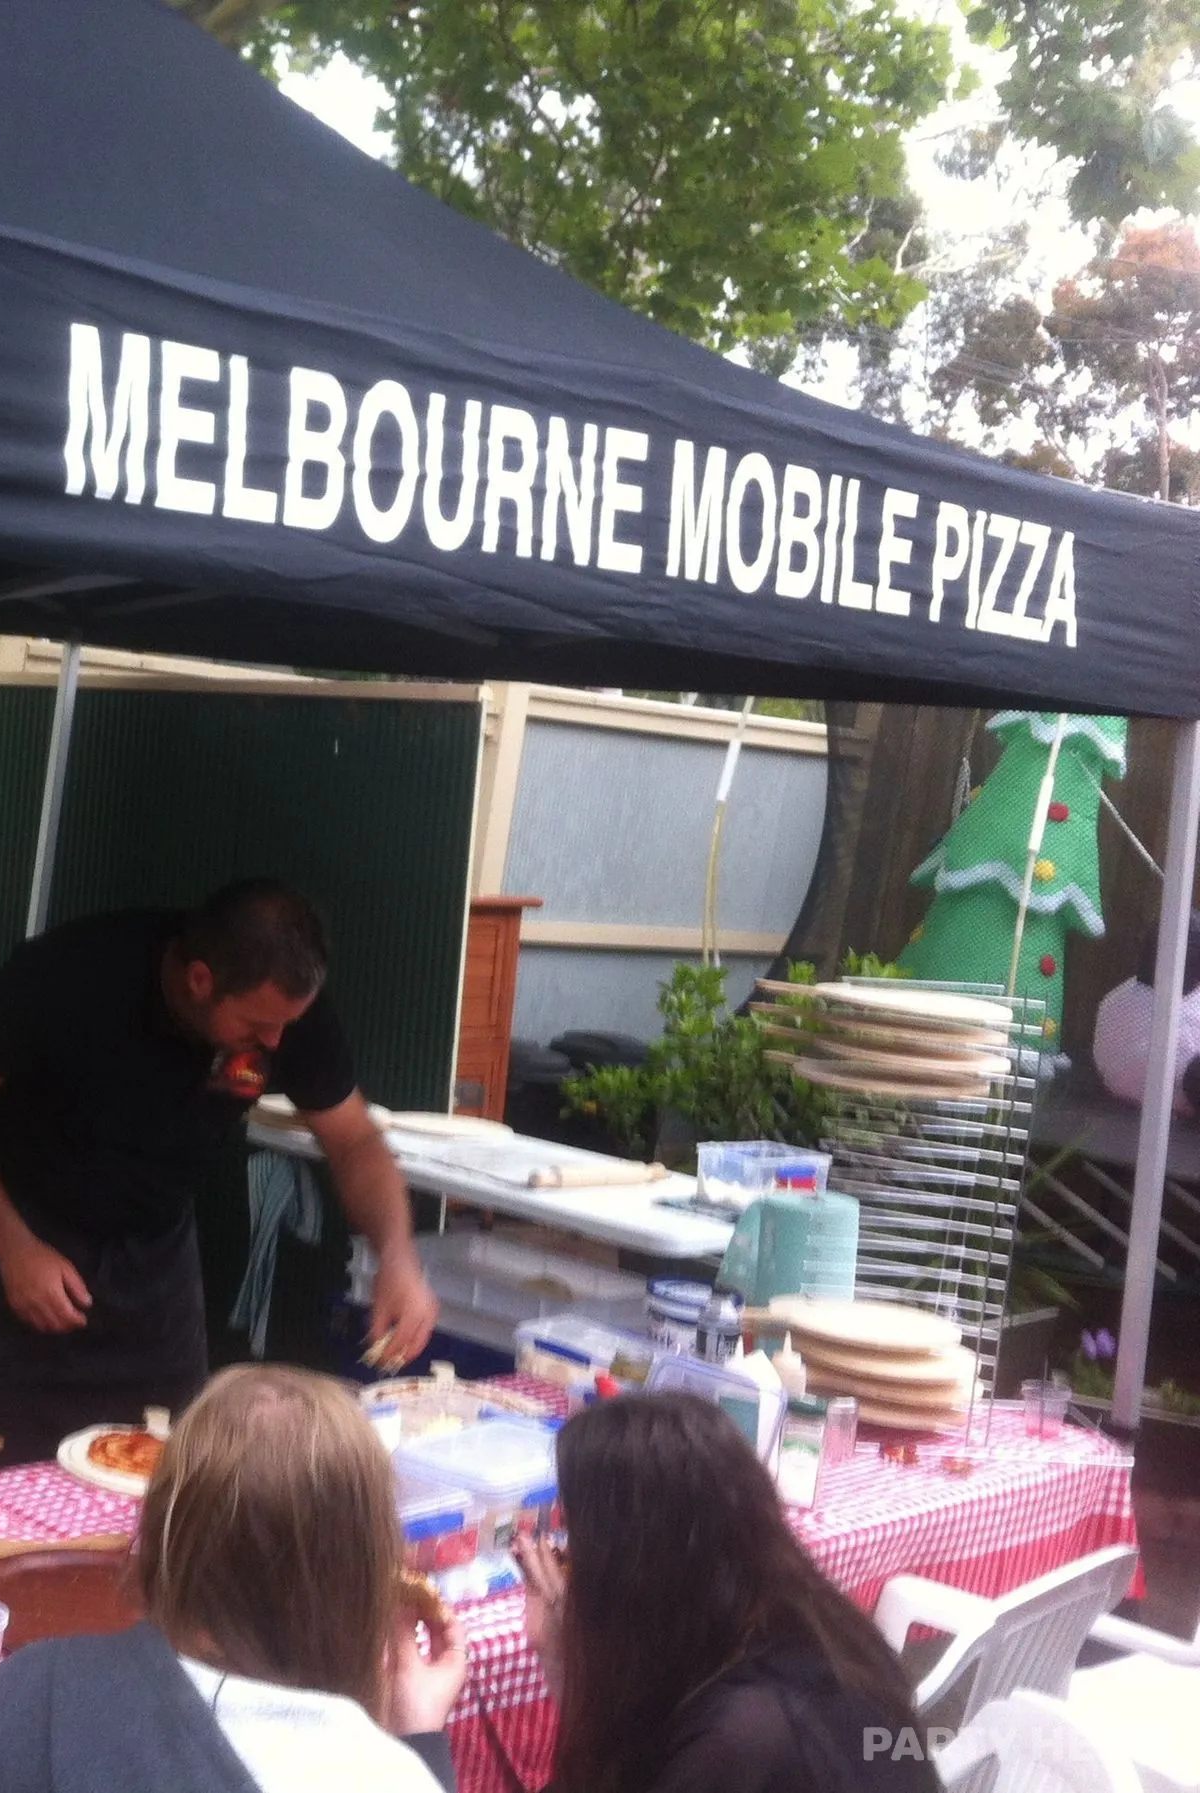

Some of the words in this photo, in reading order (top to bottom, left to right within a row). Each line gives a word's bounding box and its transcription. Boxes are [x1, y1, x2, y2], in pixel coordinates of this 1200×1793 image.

[64, 322, 648, 574] MELBOURNE
[666, 438, 920, 617] MOBILE
[929, 500, 1078, 648] PIZZA
